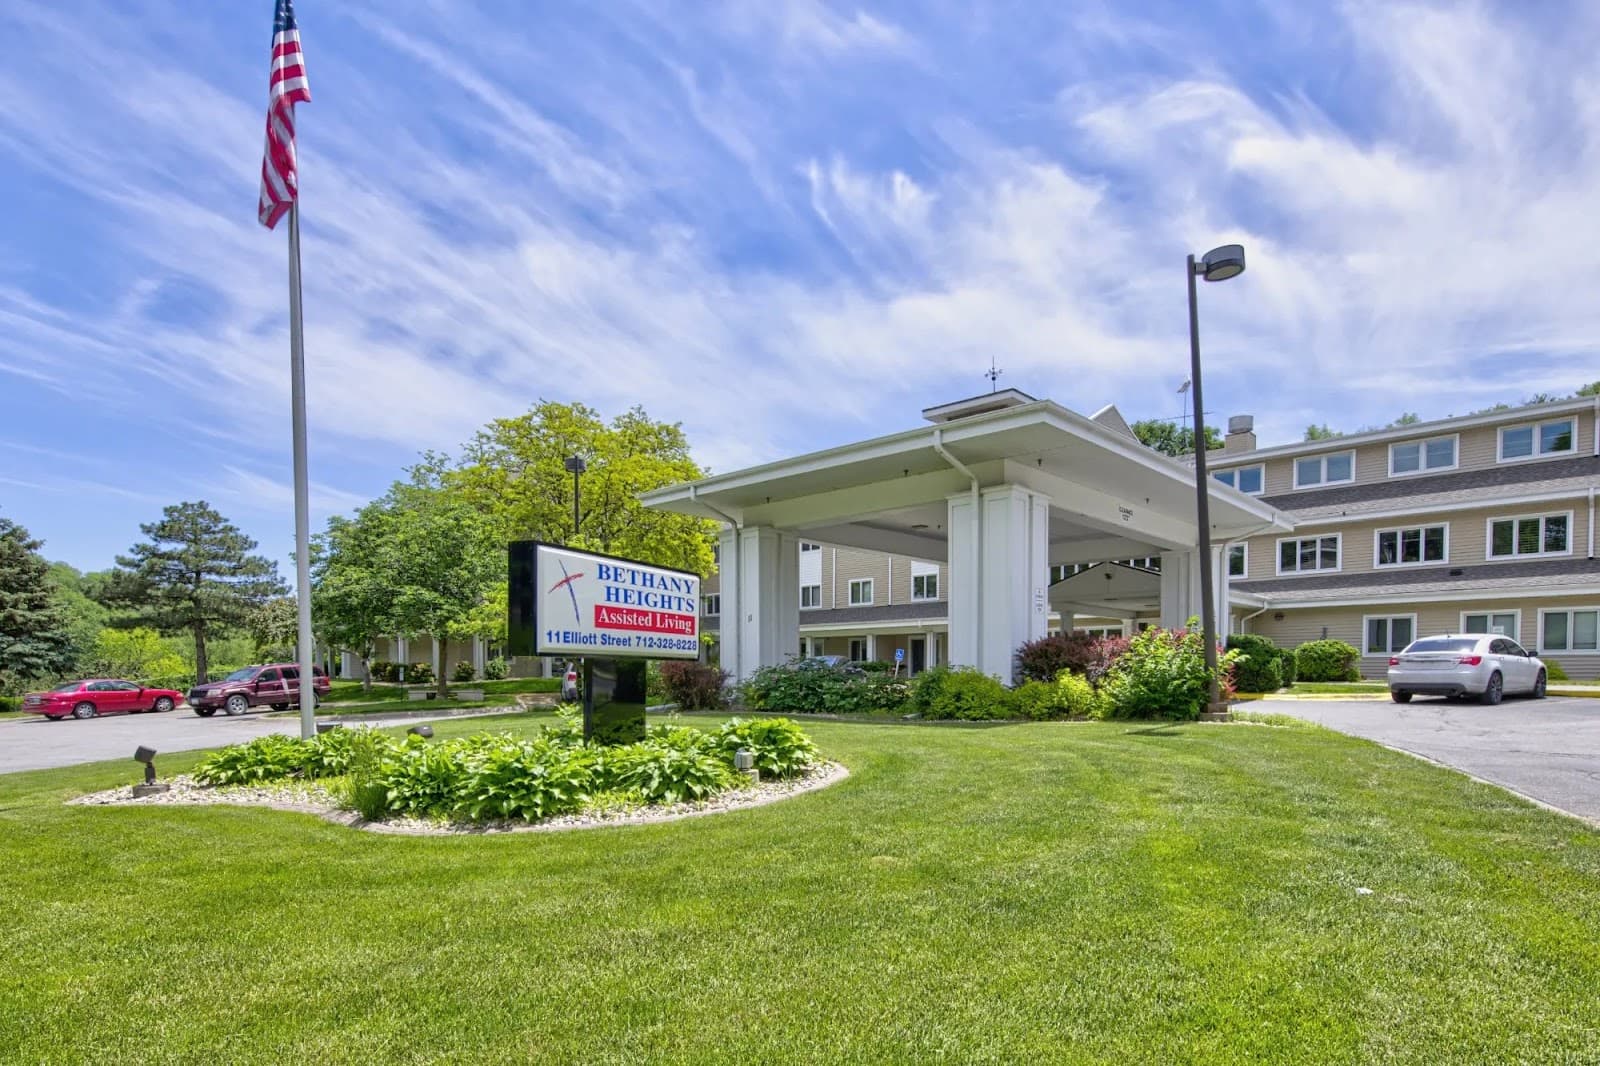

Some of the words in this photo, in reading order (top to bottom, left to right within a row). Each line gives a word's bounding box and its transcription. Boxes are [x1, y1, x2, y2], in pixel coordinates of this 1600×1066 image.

[597, 563, 695, 595] BETHANY
[604, 586, 695, 612] HEIGHTS
[599, 610, 652, 628] Assisted
[655, 613, 692, 634] Living
[546, 630, 561, 644] 11
[563, 631, 597, 646] Elliott
[600, 634, 632, 647] Street
[635, 636, 697, 651] 712-328-8228
